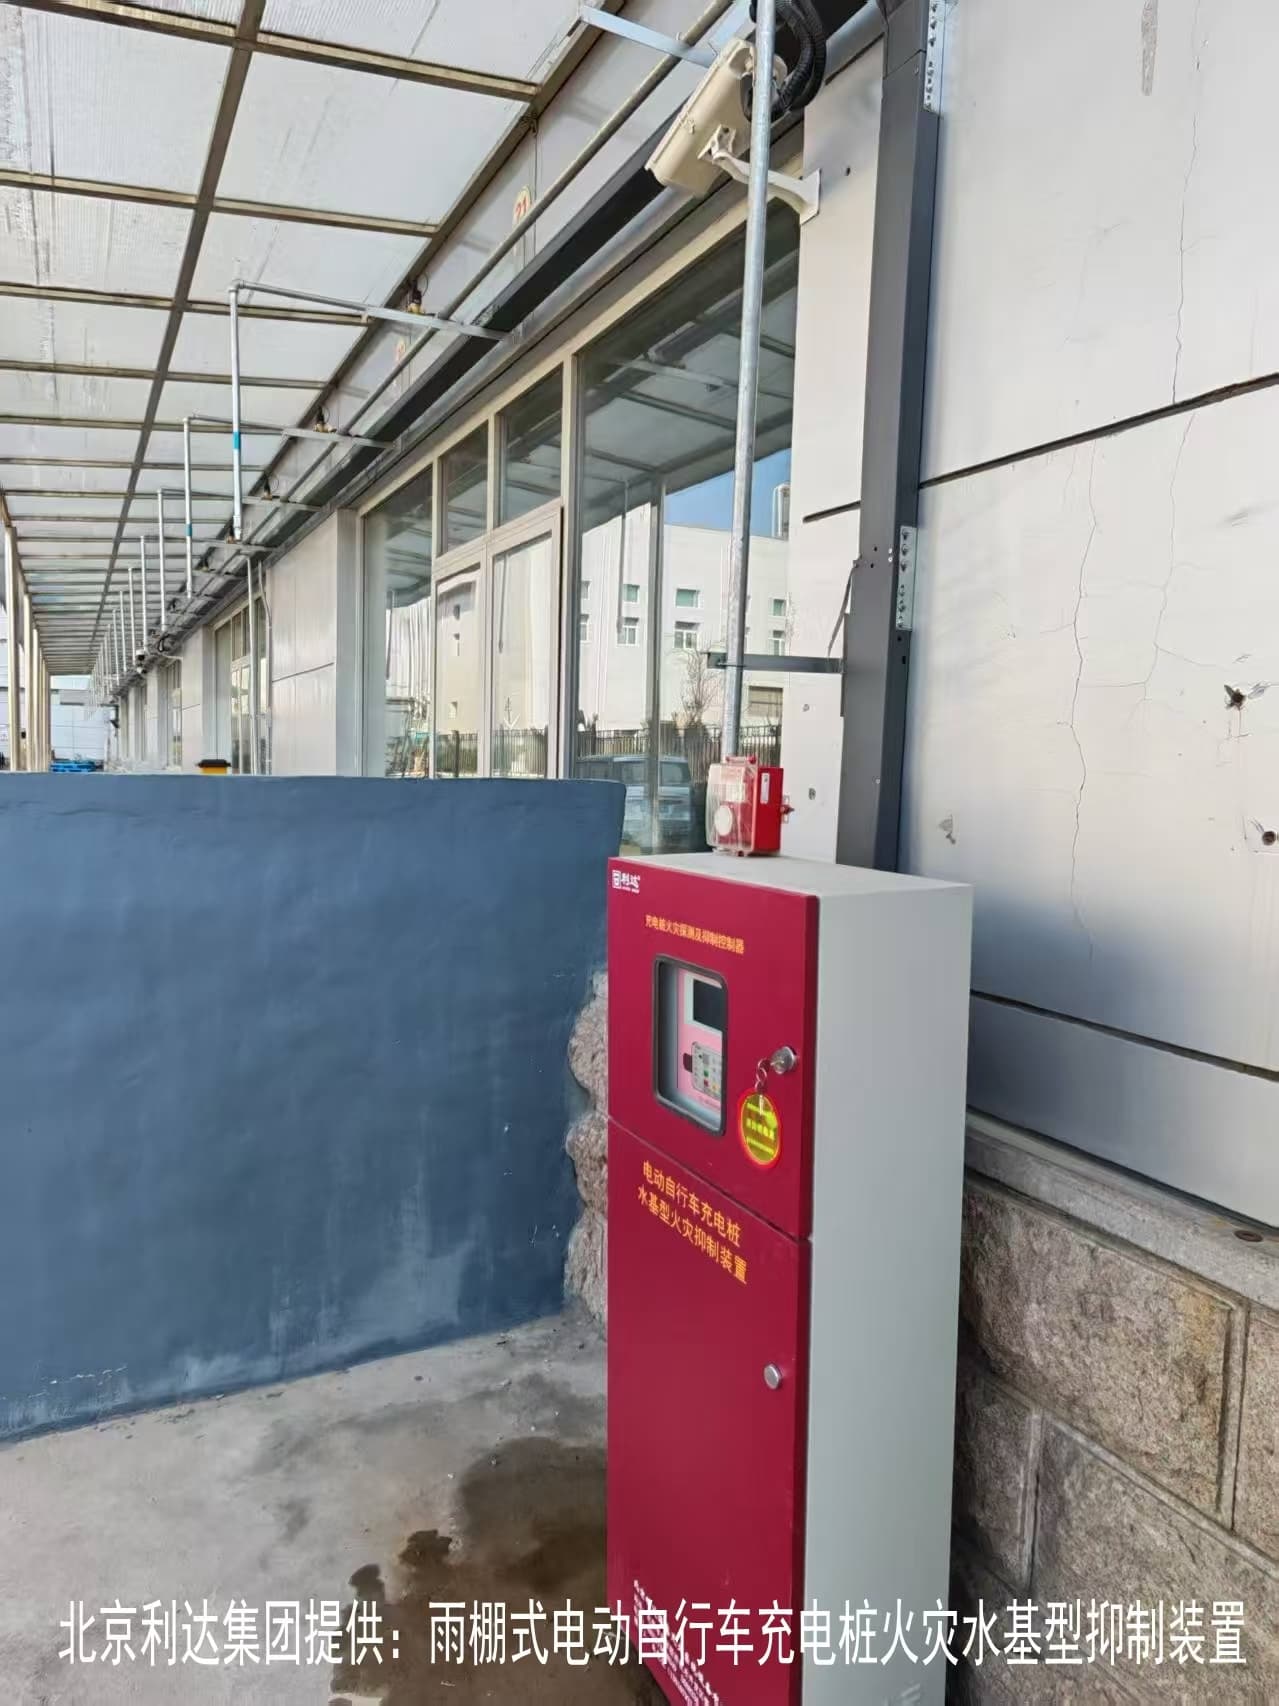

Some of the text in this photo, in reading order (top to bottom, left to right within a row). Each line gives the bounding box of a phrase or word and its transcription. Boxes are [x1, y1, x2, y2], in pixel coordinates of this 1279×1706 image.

[638, 1184, 747, 1285] 水基型火灾抑制装置
[642, 1160, 742, 1247] 电动自行车充电桩
